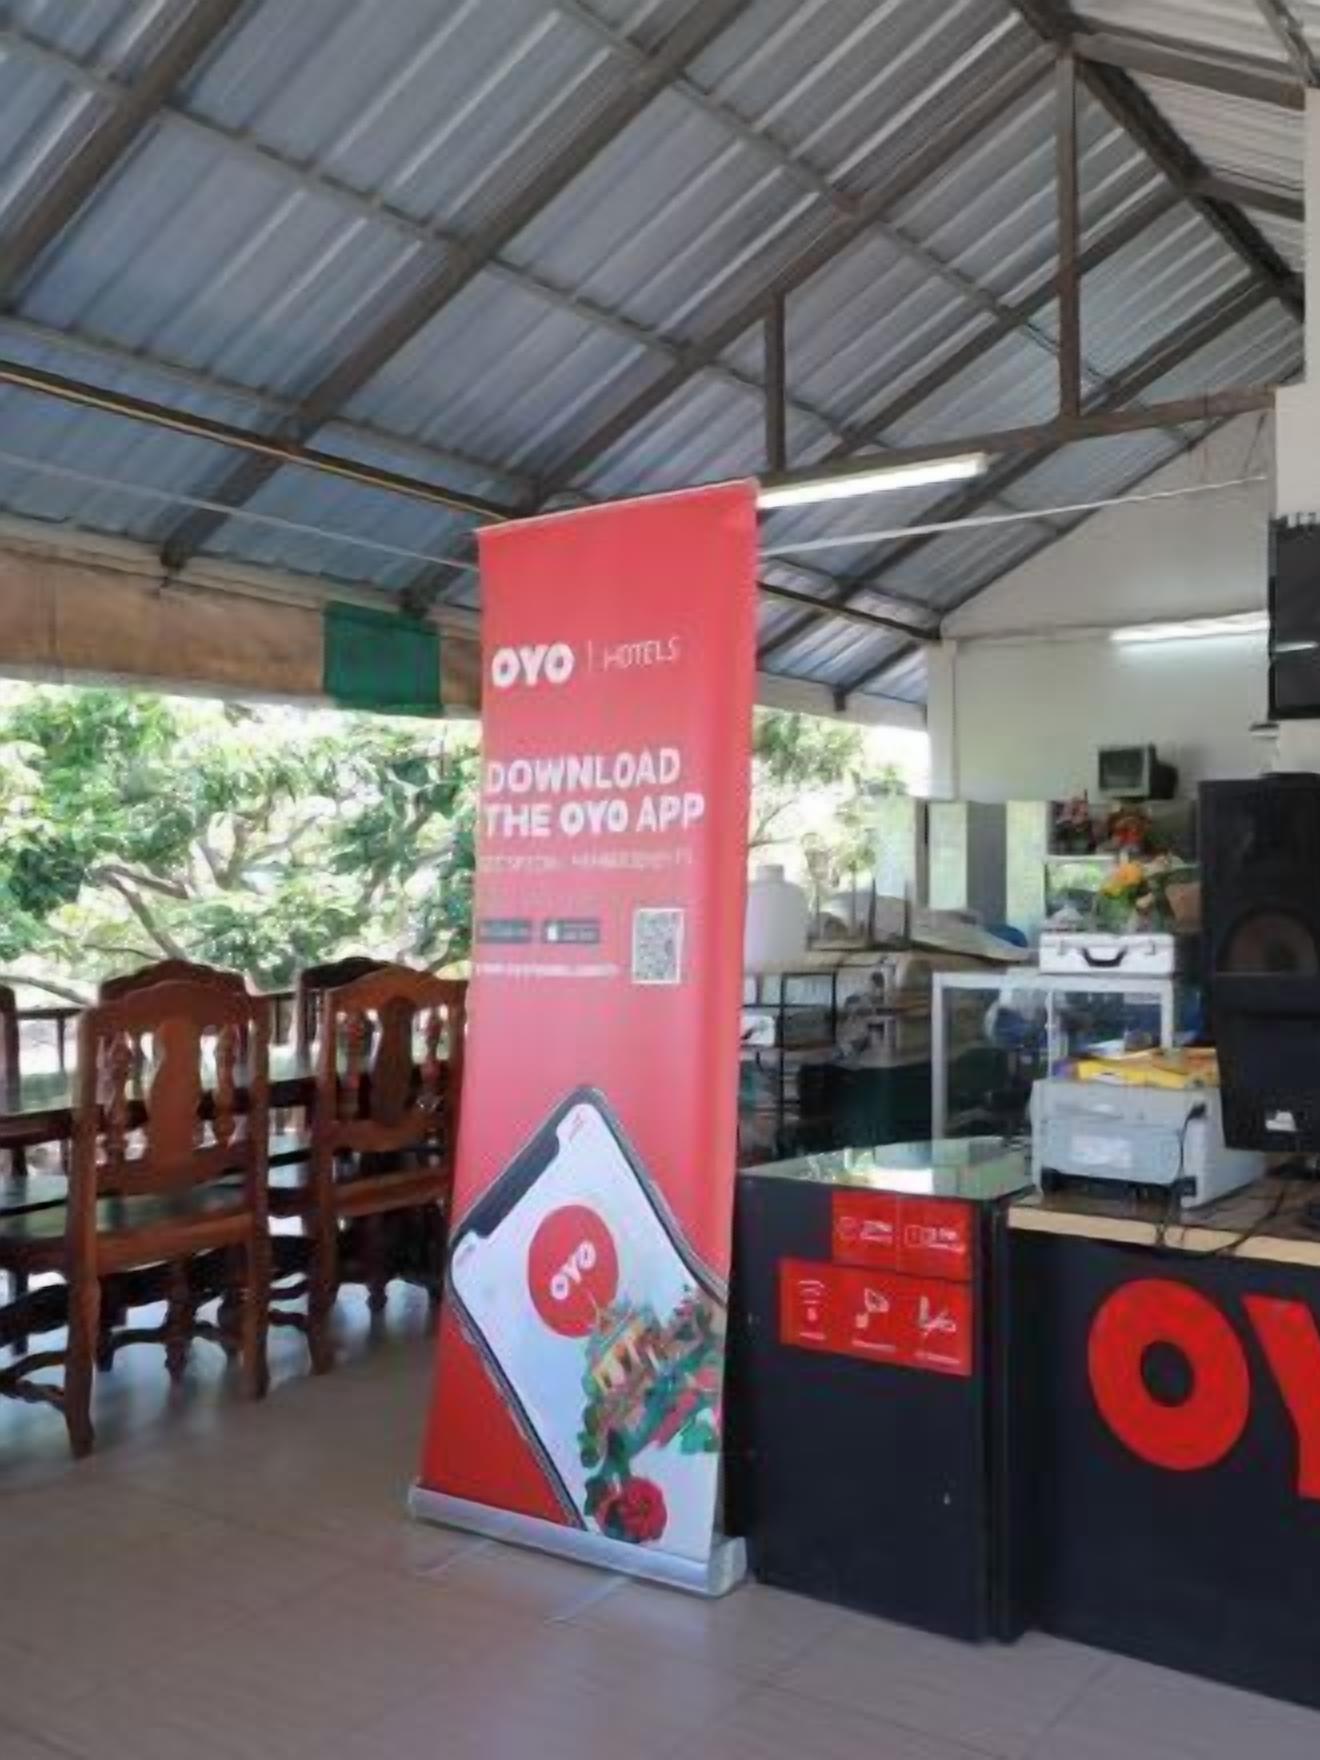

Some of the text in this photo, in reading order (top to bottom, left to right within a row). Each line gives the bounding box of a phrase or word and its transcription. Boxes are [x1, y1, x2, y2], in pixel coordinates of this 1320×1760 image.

[491, 636, 680, 688] OYO HOTELS
[485, 747, 681, 794] DOWNLOAD
[484, 792, 705, 838] THE OYO APP
[550, 1240, 597, 1300] OYO
